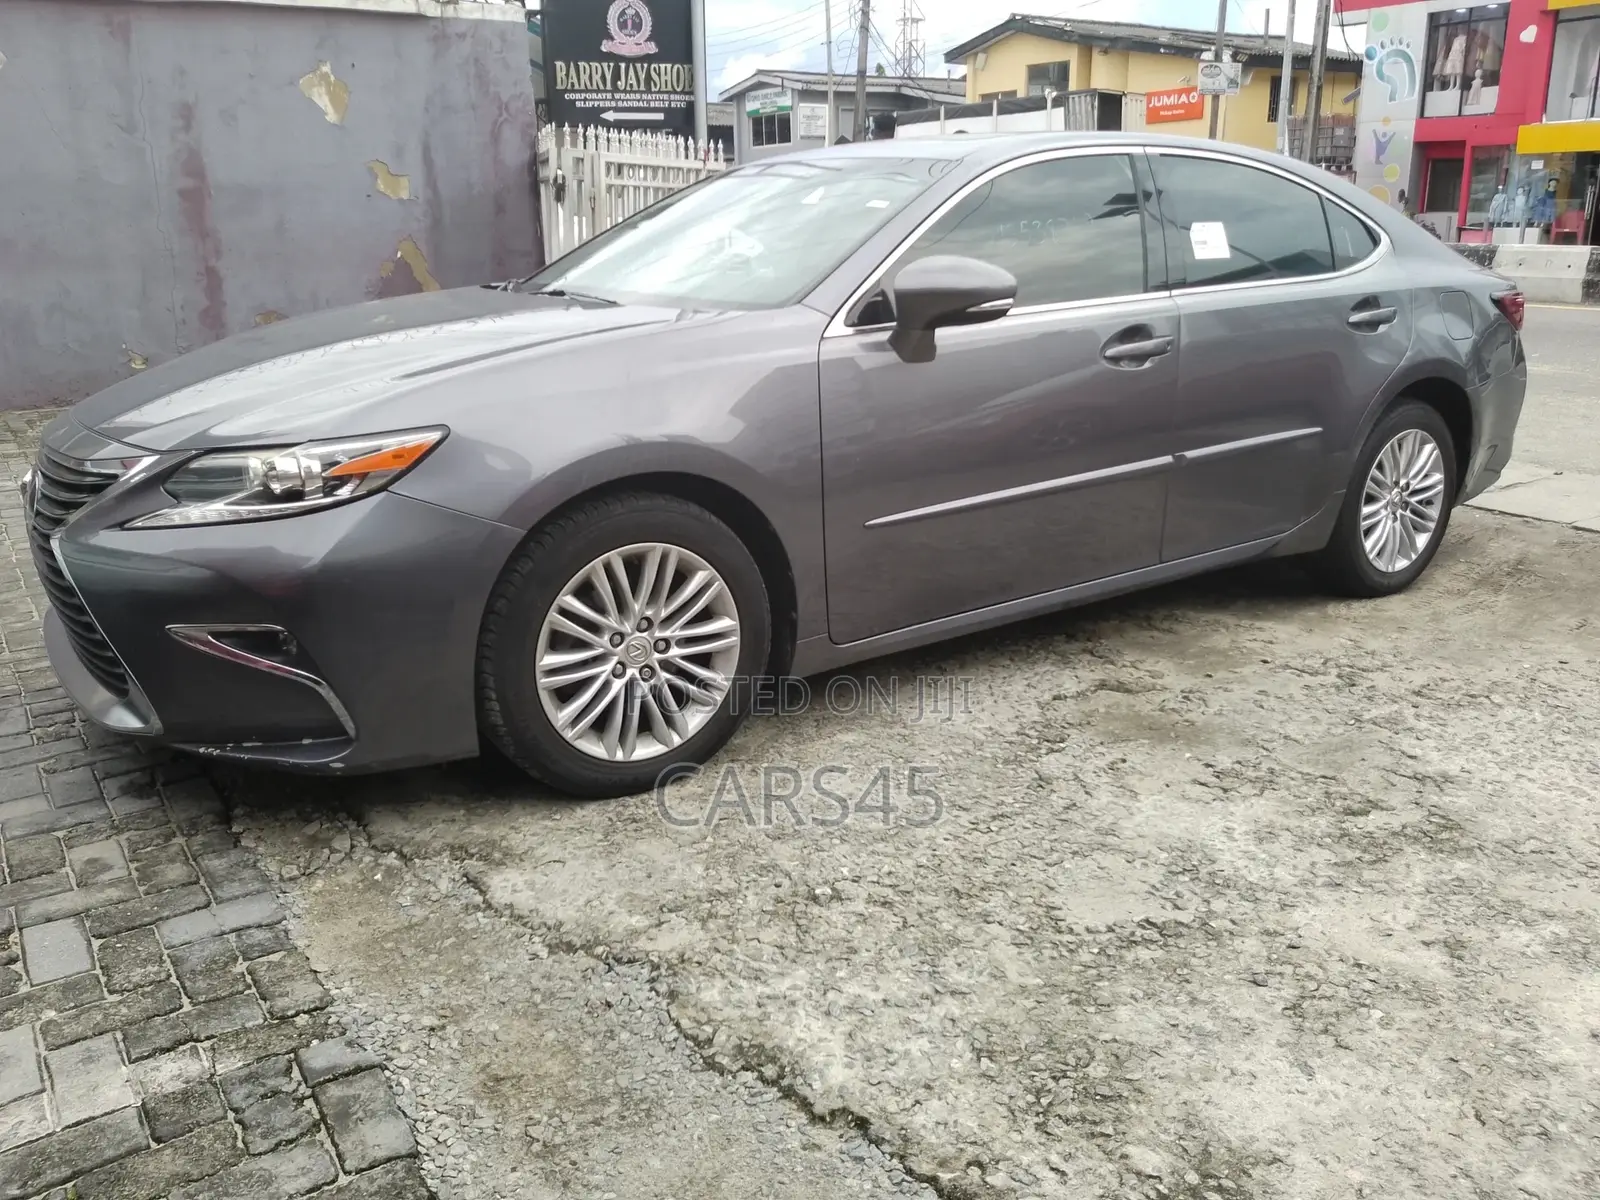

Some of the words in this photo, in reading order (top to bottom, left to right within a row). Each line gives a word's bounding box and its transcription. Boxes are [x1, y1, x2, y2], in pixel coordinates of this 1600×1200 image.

[554, 61, 614, 90] BARRY
[616, 62, 648, 91] JAY
[564, 92, 613, 100] CORPORATE
[641, 93, 669, 101] NATIVE
[1149, 93, 1189, 107] JUMIA
[575, 100, 616, 108] SLIPPERS
[617, 100, 649, 108] SANDAL
